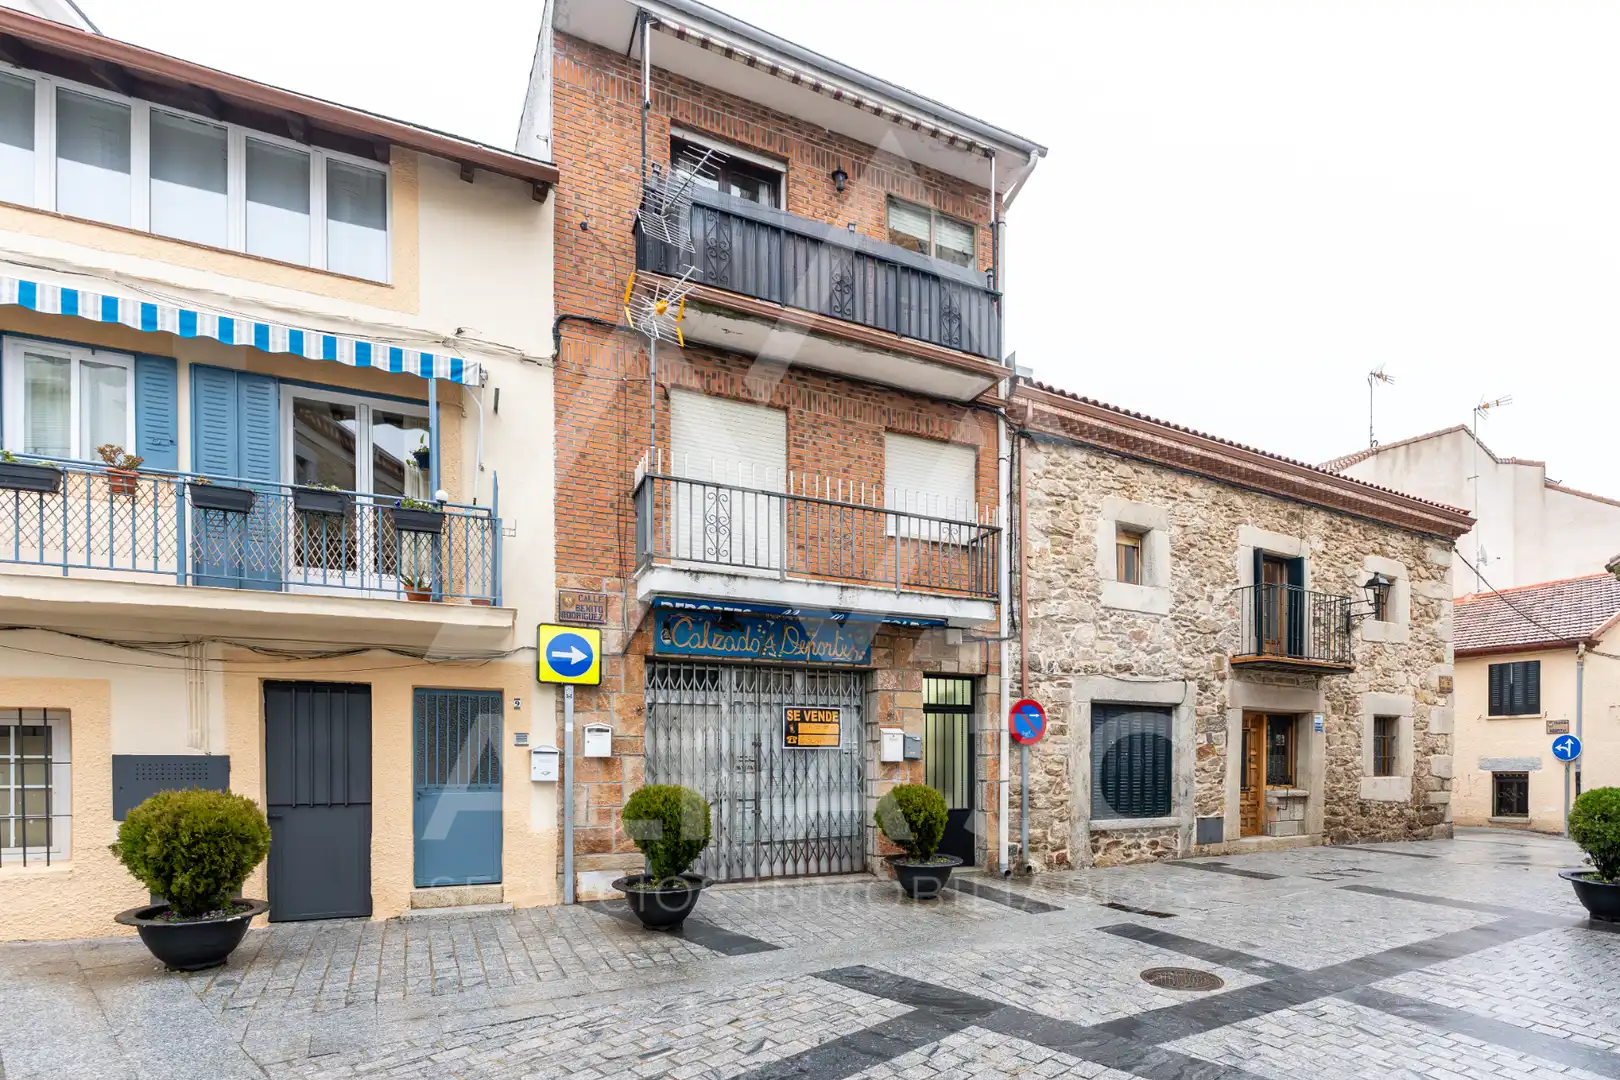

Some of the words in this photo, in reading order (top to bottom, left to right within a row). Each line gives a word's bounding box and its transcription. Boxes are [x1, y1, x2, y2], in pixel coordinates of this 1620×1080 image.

[578, 594, 604, 604] CALLE
[575, 604, 603, 613] BENITO
[560, 611, 603, 621] RODRIGUEZ
[781, 625, 859, 661] Deportes
[786, 709, 801, 722] SE
[803, 710, 839, 722] VENDE
